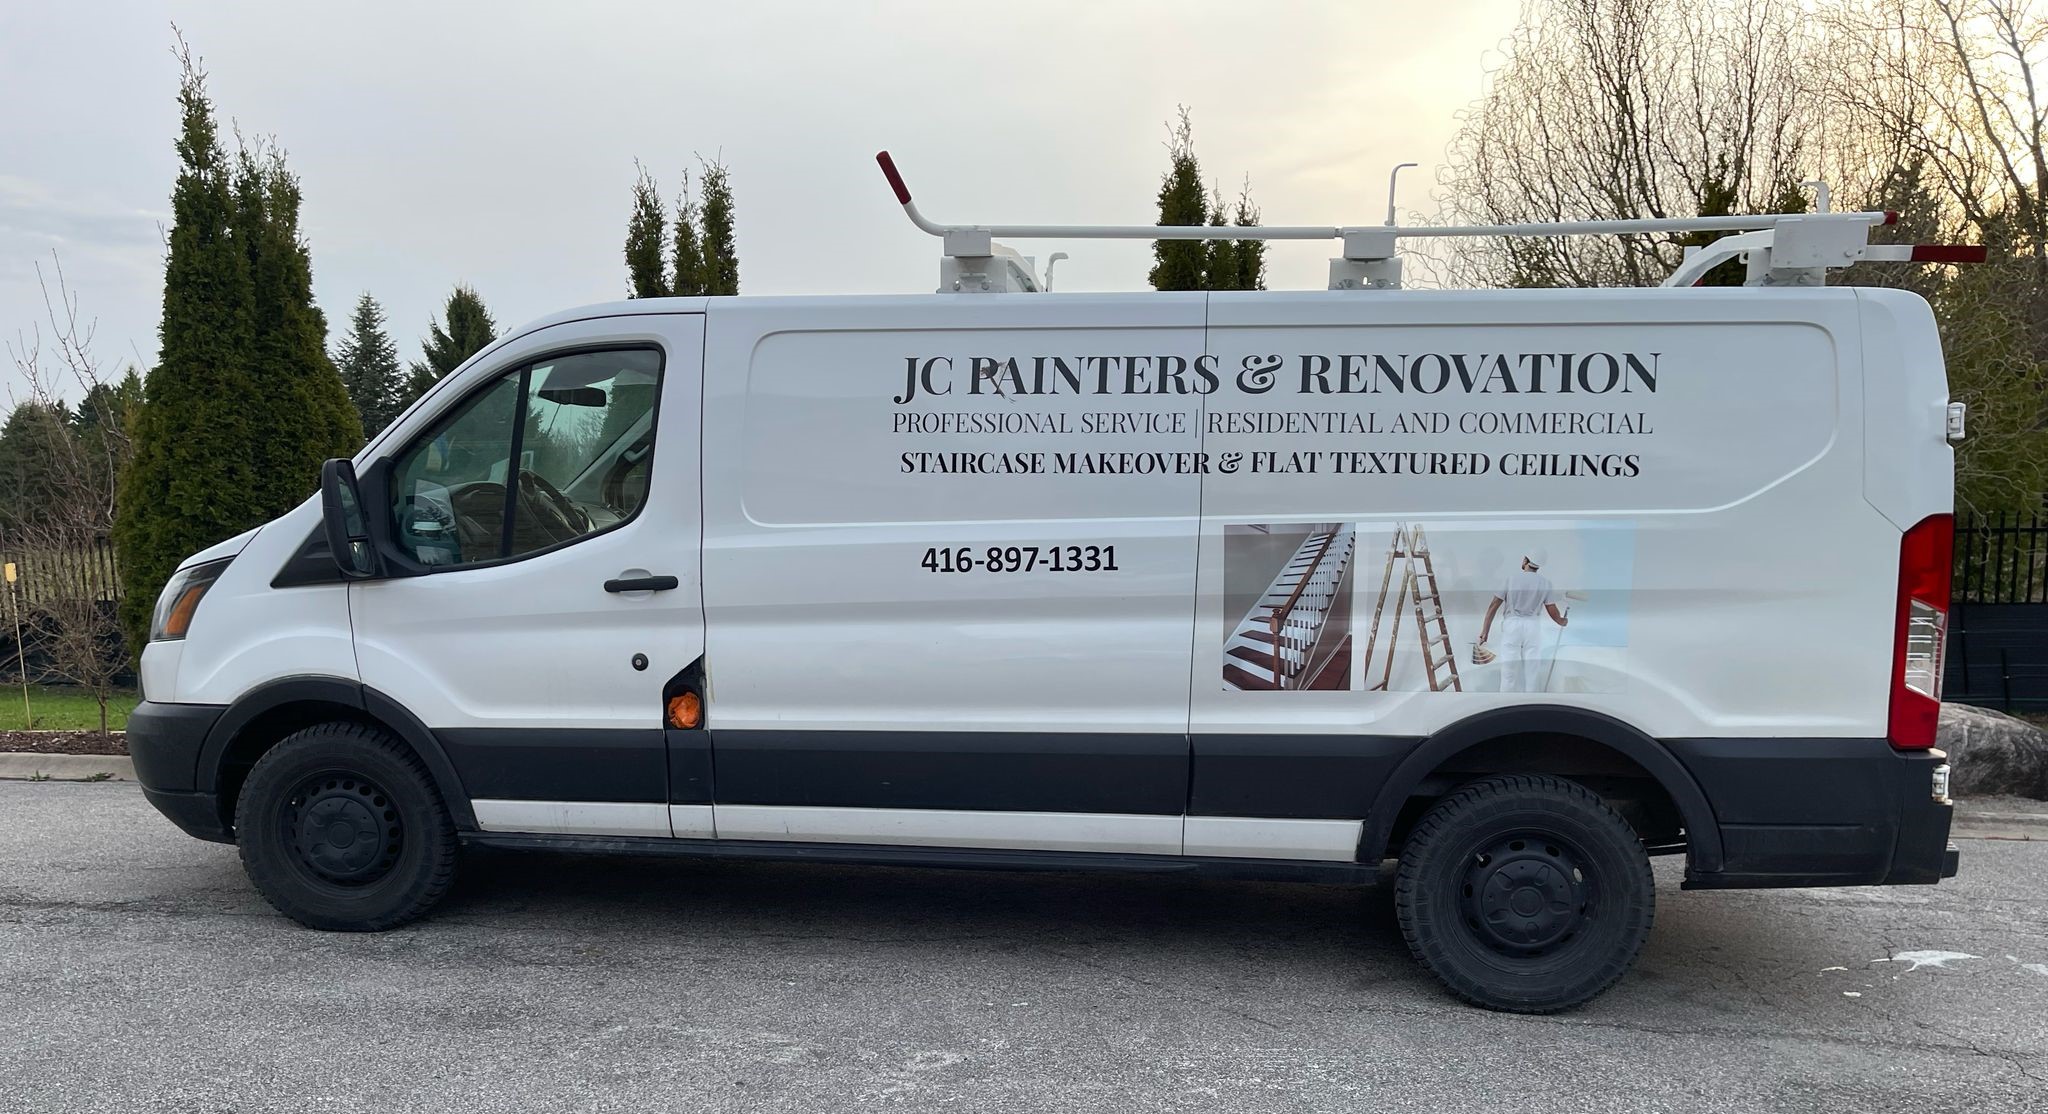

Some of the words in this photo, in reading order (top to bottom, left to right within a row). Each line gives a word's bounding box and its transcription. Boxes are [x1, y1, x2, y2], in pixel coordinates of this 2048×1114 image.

[894, 355, 954, 404] JC
[968, 354, 1220, 396] PAINTERS
[1236, 354, 1283, 395] &
[1298, 352, 1662, 395] RENOVATION
[893, 412, 1073, 434] PROFESSIONAL
[1080, 412, 1185, 434] SERVICE
[1208, 411, 1382, 435] RESIDENTIAL
[1390, 411, 1450, 435] AND
[1459, 411, 1654, 435] COMMERCIAL
[900, 451, 1045, 474] STAIRCASE
[1053, 451, 1209, 474] MAKEOVER
[1218, 451, 1243, 474] &
[1251, 450, 1322, 474] FLAT
[1330, 451, 1490, 476] TEXTURED
[1499, 452, 1640, 478] CEILINGS
[921, 545, 1119, 573] 416-897-1331
